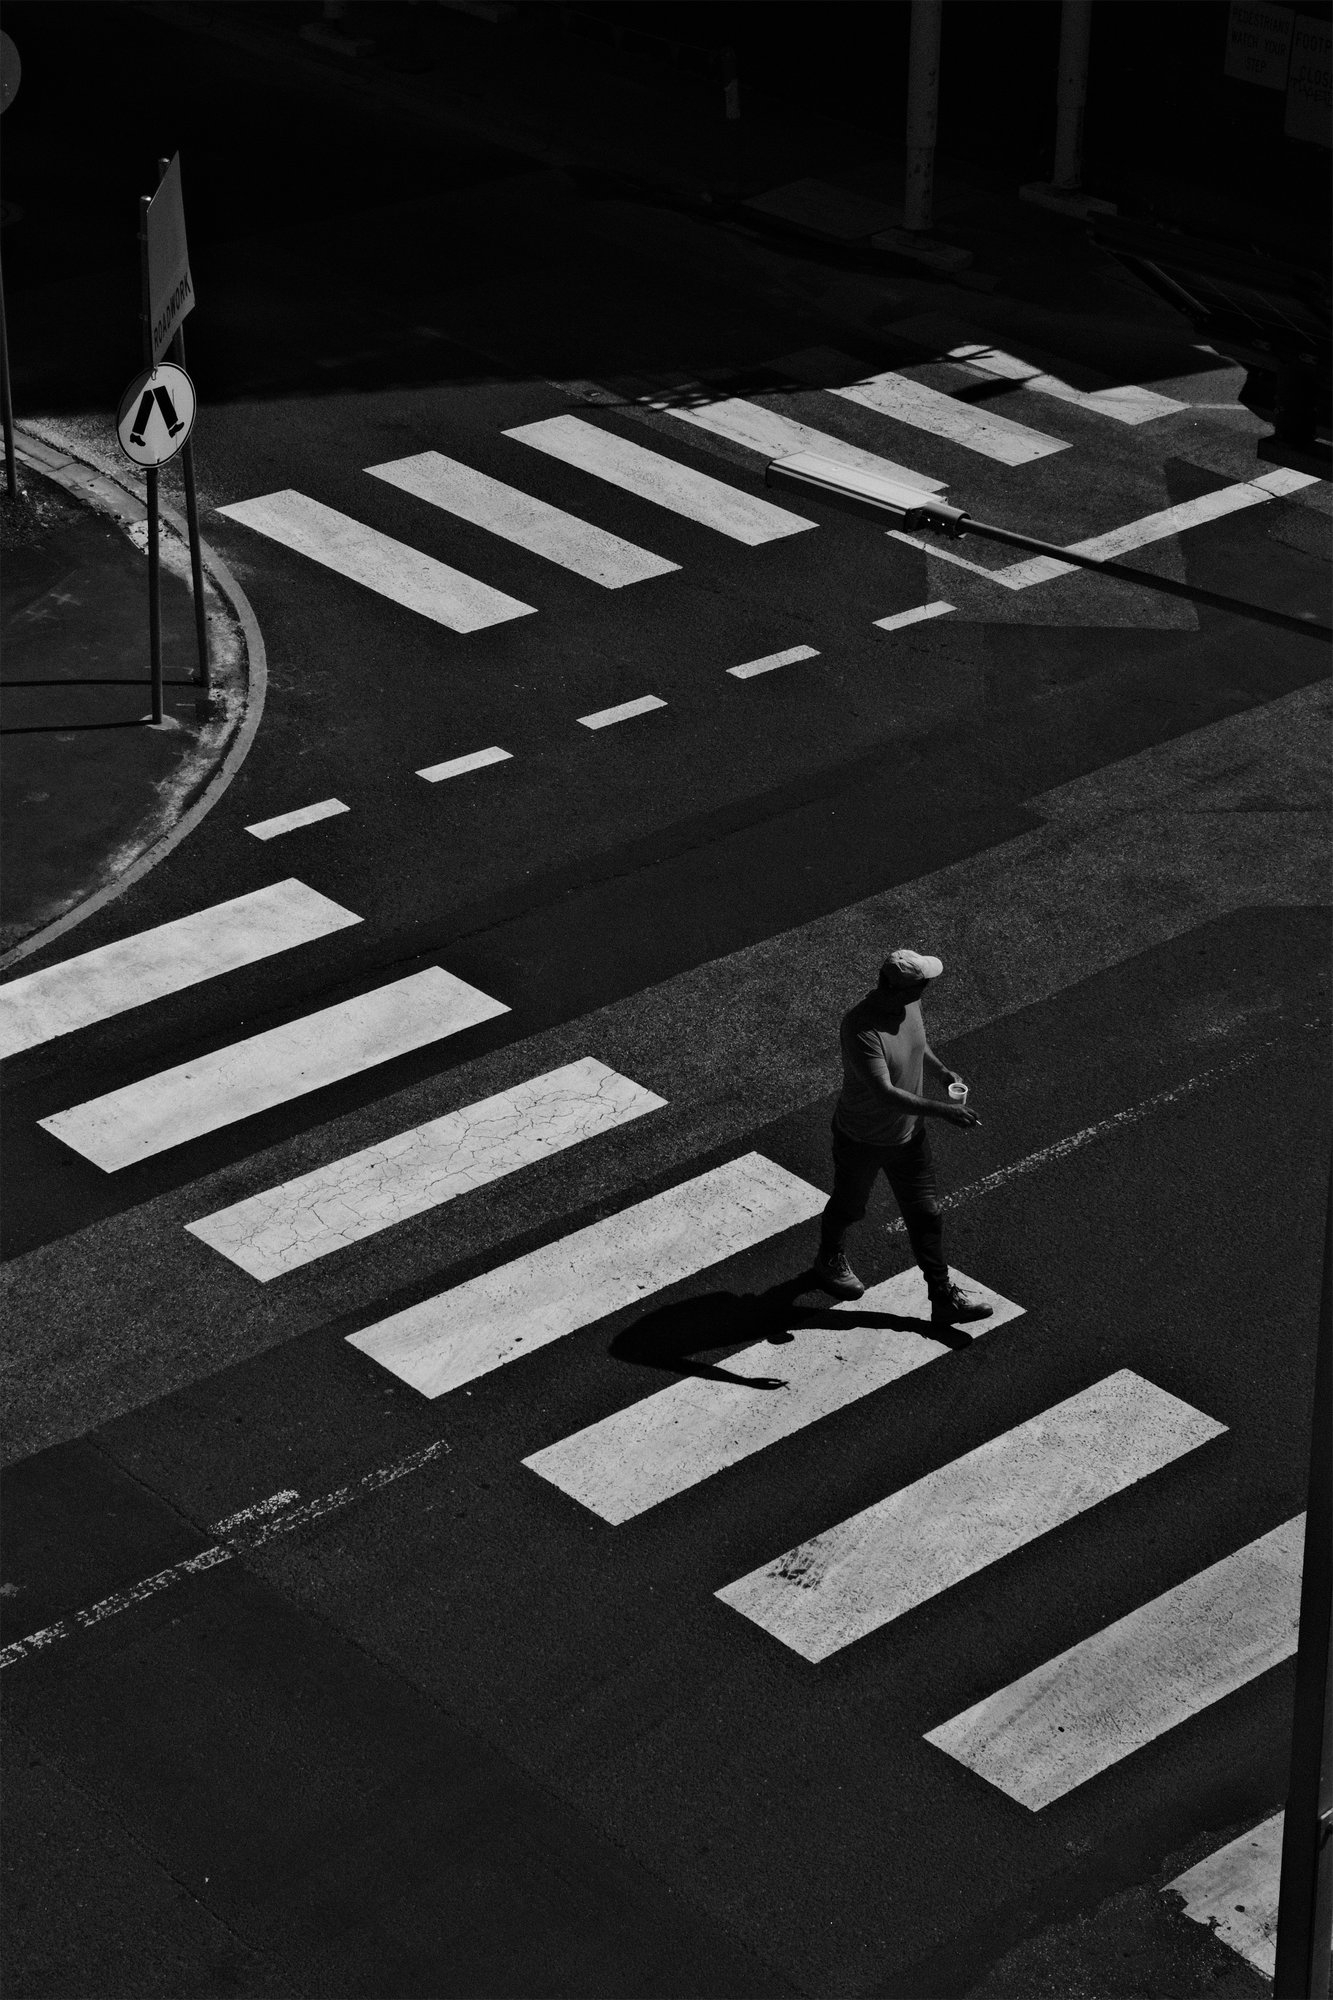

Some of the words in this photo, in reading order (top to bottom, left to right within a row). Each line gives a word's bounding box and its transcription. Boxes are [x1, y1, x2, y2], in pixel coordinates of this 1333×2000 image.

[1231, 30, 1258, 49] WATCH
[1264, 40, 1287, 57] YOUR
[1243, 57, 1267, 73] STEP
[1299, 65, 1332, 89] CLOS
[154, 272, 191, 352] ROADWORK
